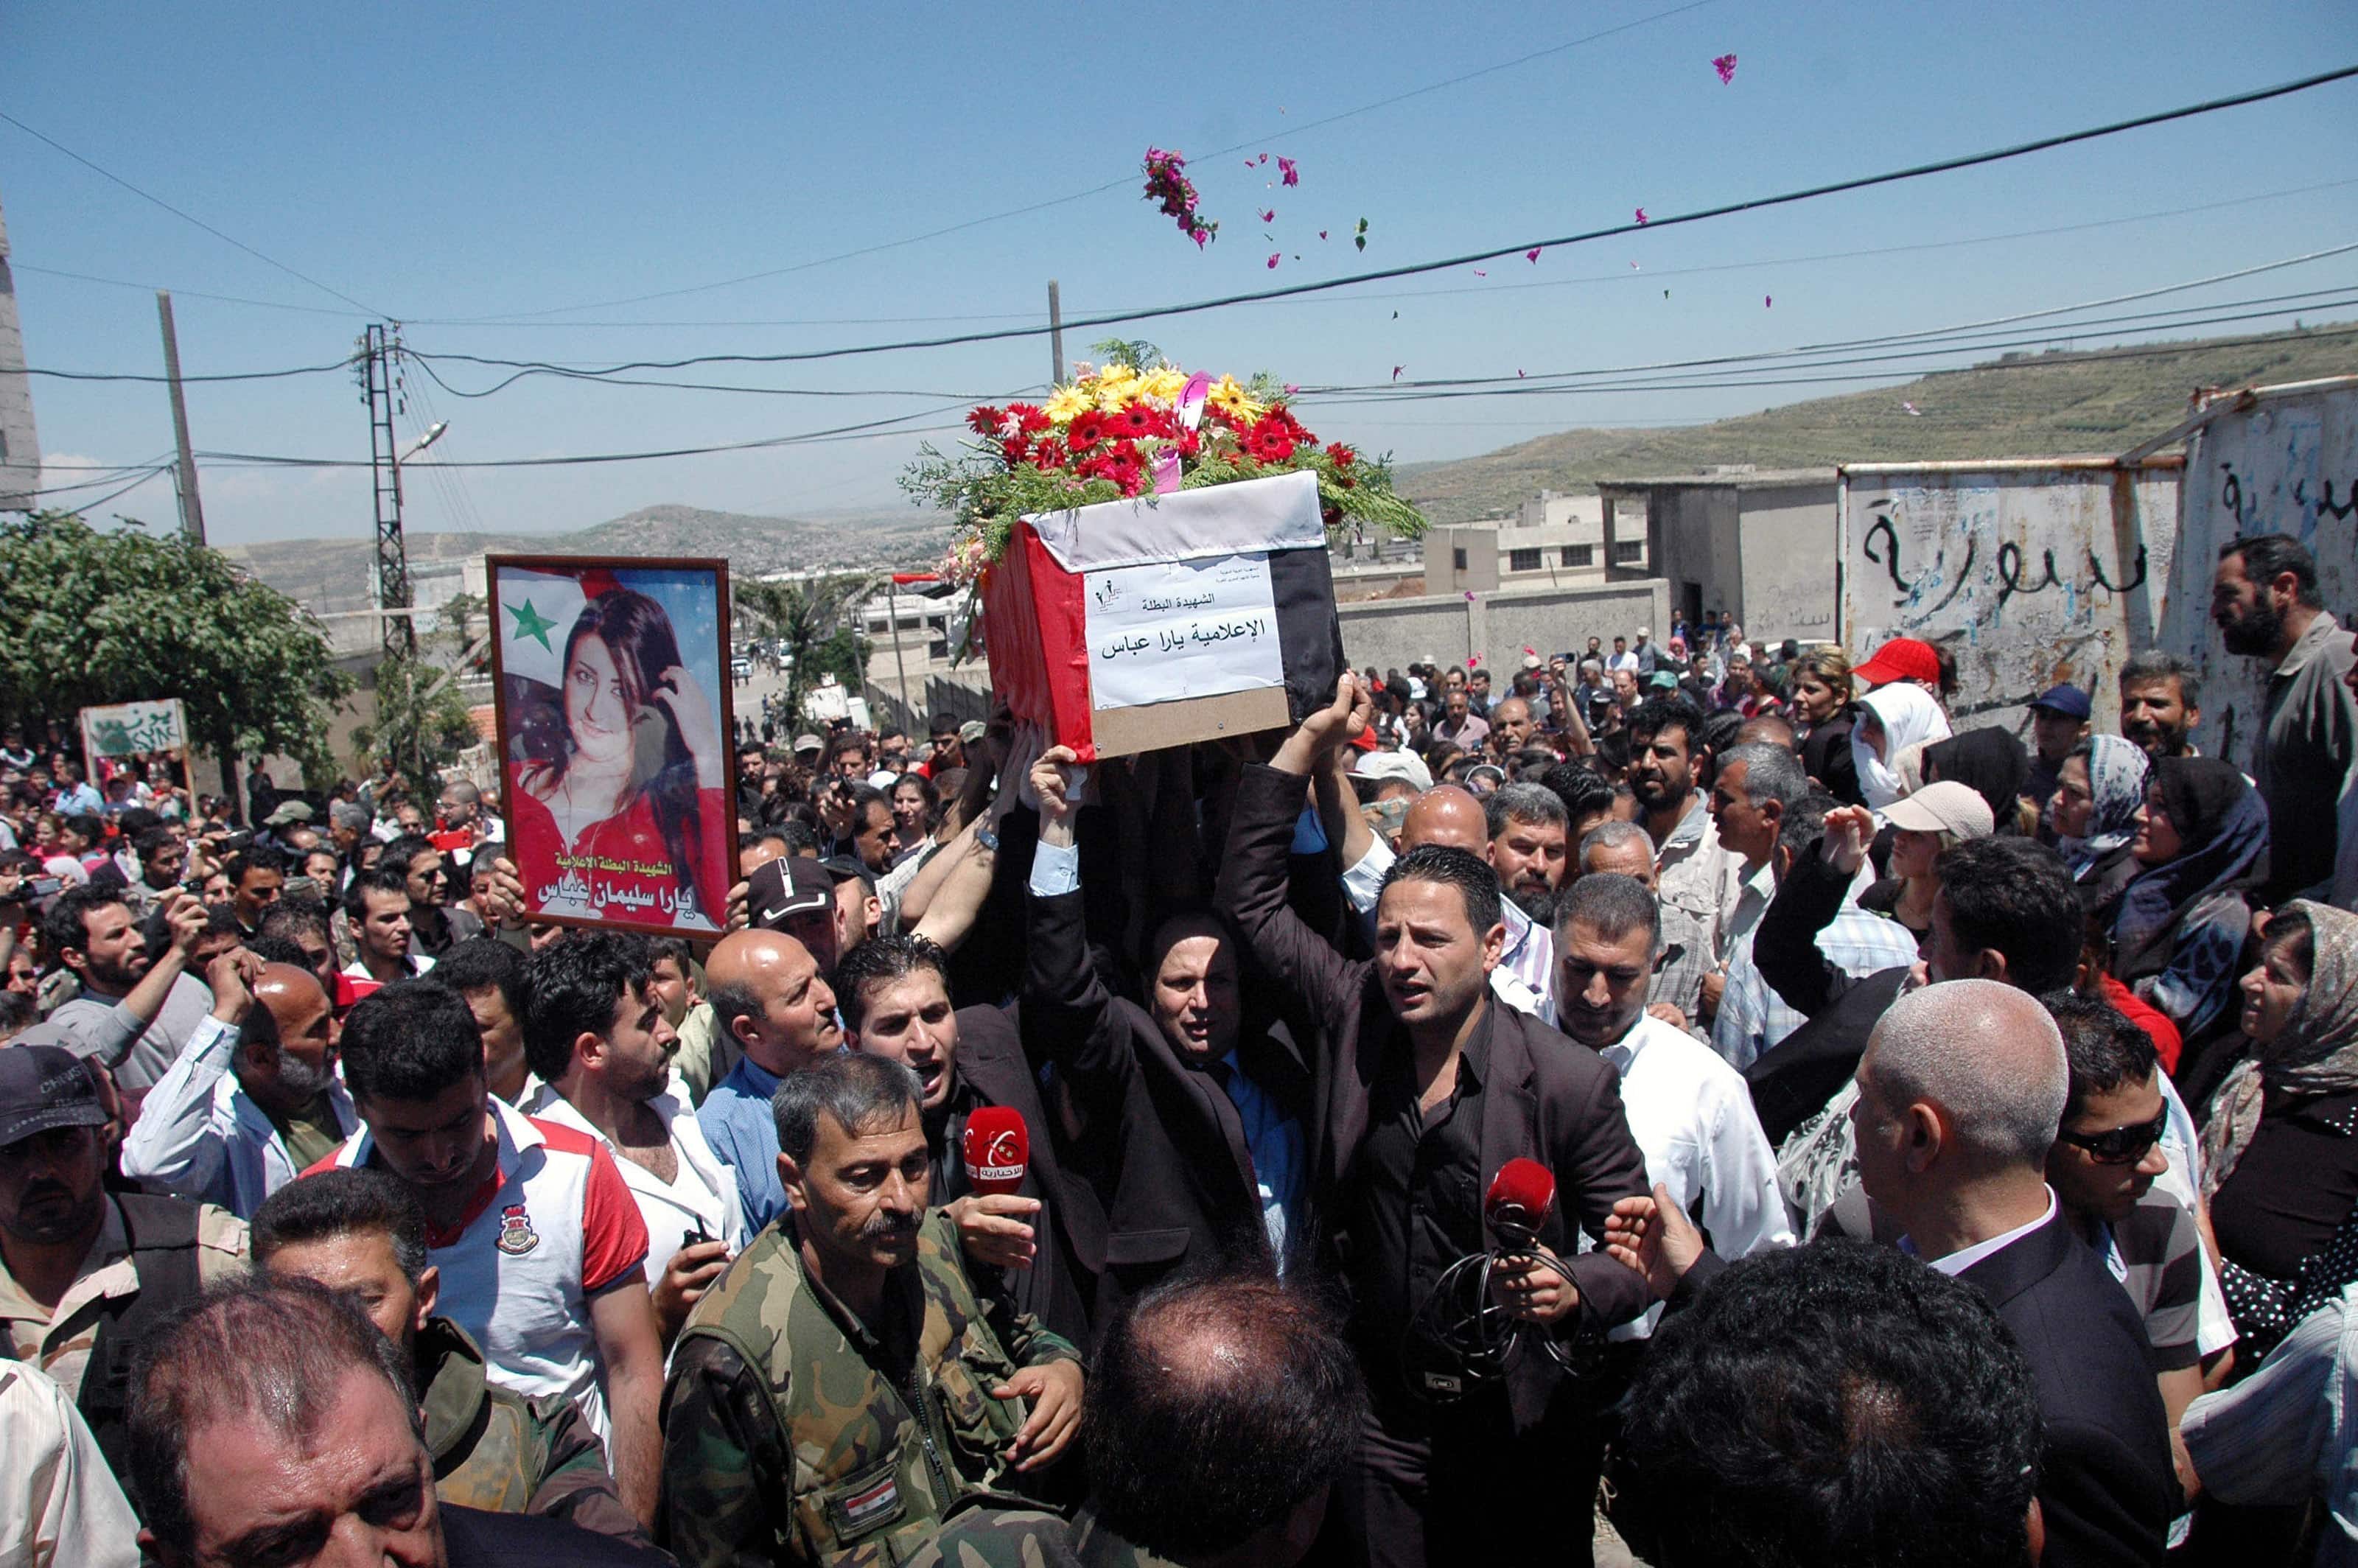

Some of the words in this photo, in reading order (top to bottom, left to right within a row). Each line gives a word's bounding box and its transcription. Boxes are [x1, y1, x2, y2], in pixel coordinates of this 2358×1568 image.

[1141, 598, 1172, 612] البطلة
[1176, 593, 1215, 609] الشهيدة
[1159, 629, 1185, 651] يارا
[1191, 618, 1265, 647] الإعلامية
[1101, 634, 1150, 659] عباس
[598, 855, 630, 875] البطلة
[632, 860, 672, 878] الشهيدة
[537, 876, 590, 907] عباس
[593, 881, 655, 912] سليمان
[659, 886, 696, 920] يارا
